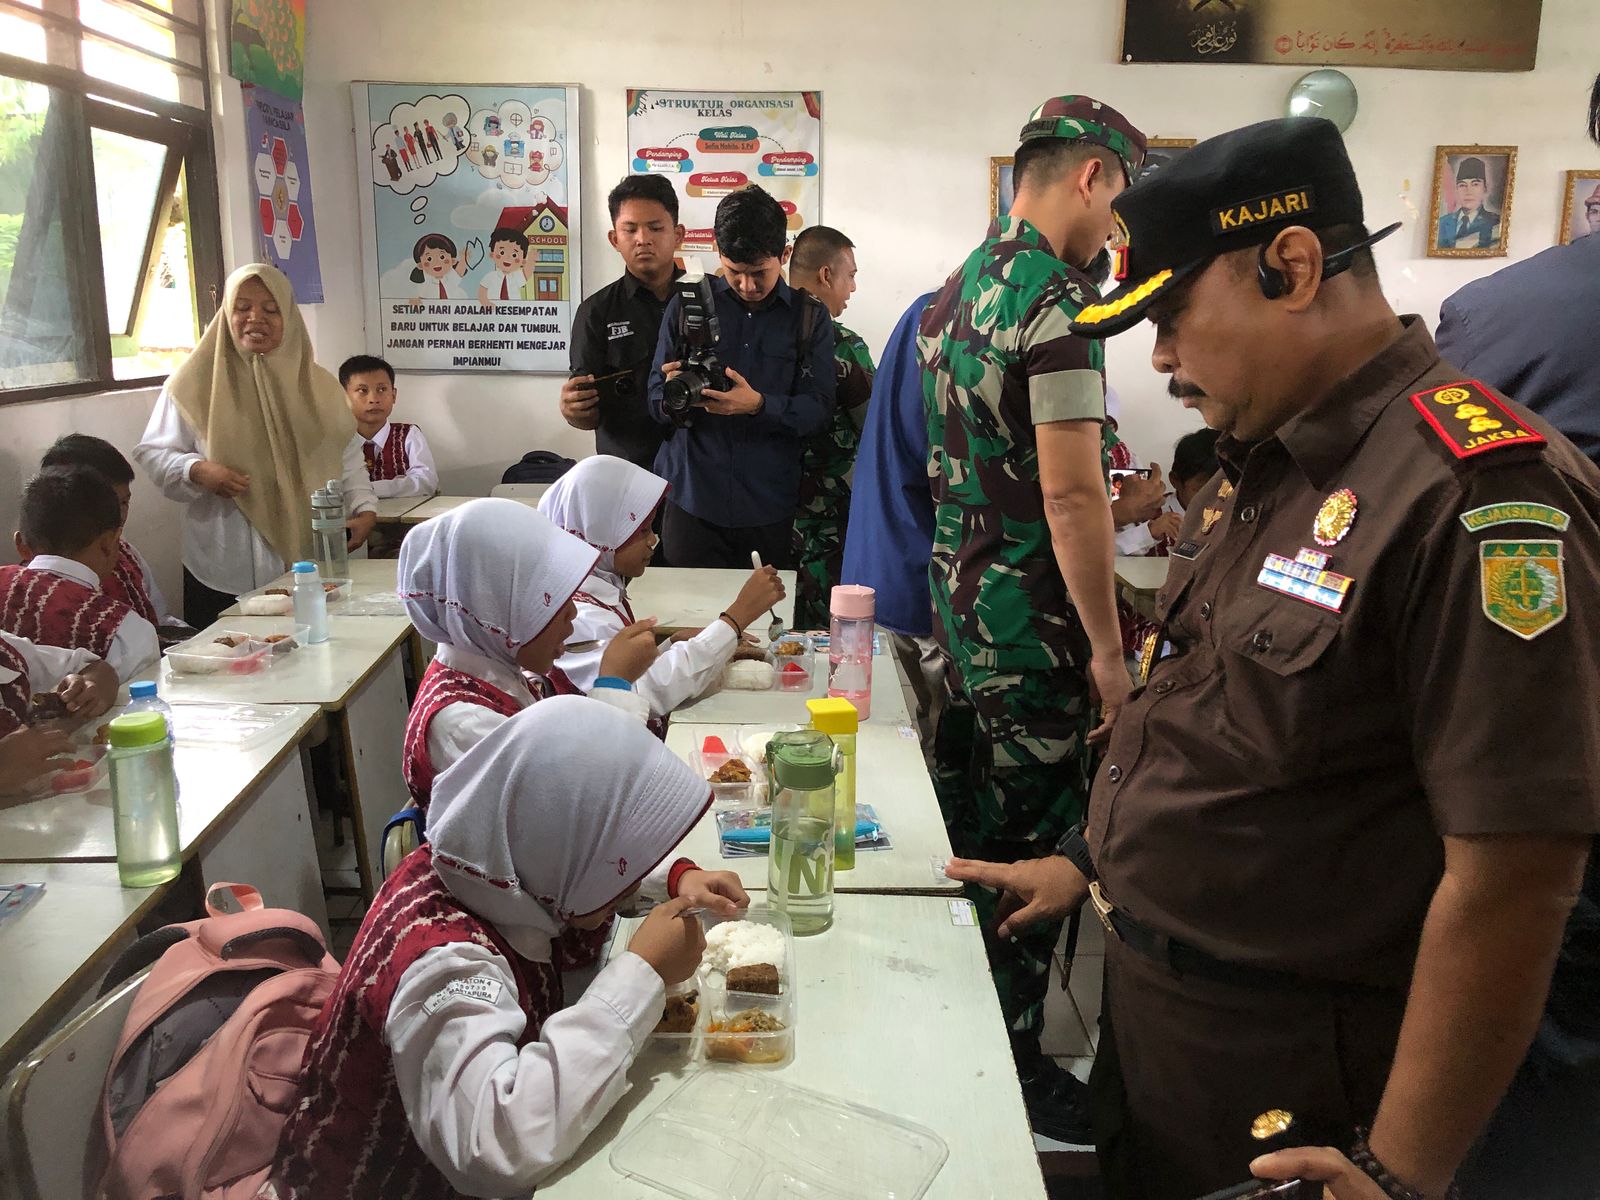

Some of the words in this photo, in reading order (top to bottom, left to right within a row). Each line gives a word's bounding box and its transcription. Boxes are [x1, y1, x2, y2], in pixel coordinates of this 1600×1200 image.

[659, 98, 724, 109] STRUKTUR
[730, 99, 794, 108] ORGANISASI
[697, 108, 733, 117] KELAS
[645, 150, 682, 160] Pendamping
[770, 155, 807, 165] Pendamping
[720, 175, 738, 183] Kelas
[1218, 191, 1310, 230] KAJARI
[530, 236, 565, 244] SCHOOL
[392, 304, 426, 315] SETIAP
[428, 305, 450, 315] HARI
[454, 306, 492, 316] ADALAH
[495, 306, 558, 317] KESEMPATAN
[390, 322, 416, 332] BARU
[419, 322, 450, 332] UNTUK
[452, 323, 495, 333] BELAJAR
[499, 323, 518, 333] DAN
[520, 324, 561, 334] TUMBUH.
[386, 338, 425, 349] JANGAN
[427, 339, 465, 349] PERNAH
[468, 340, 514, 350] BERHENTI
[516, 341, 566, 351] MENGEJAR
[1464, 429, 1531, 450] JAKSA
